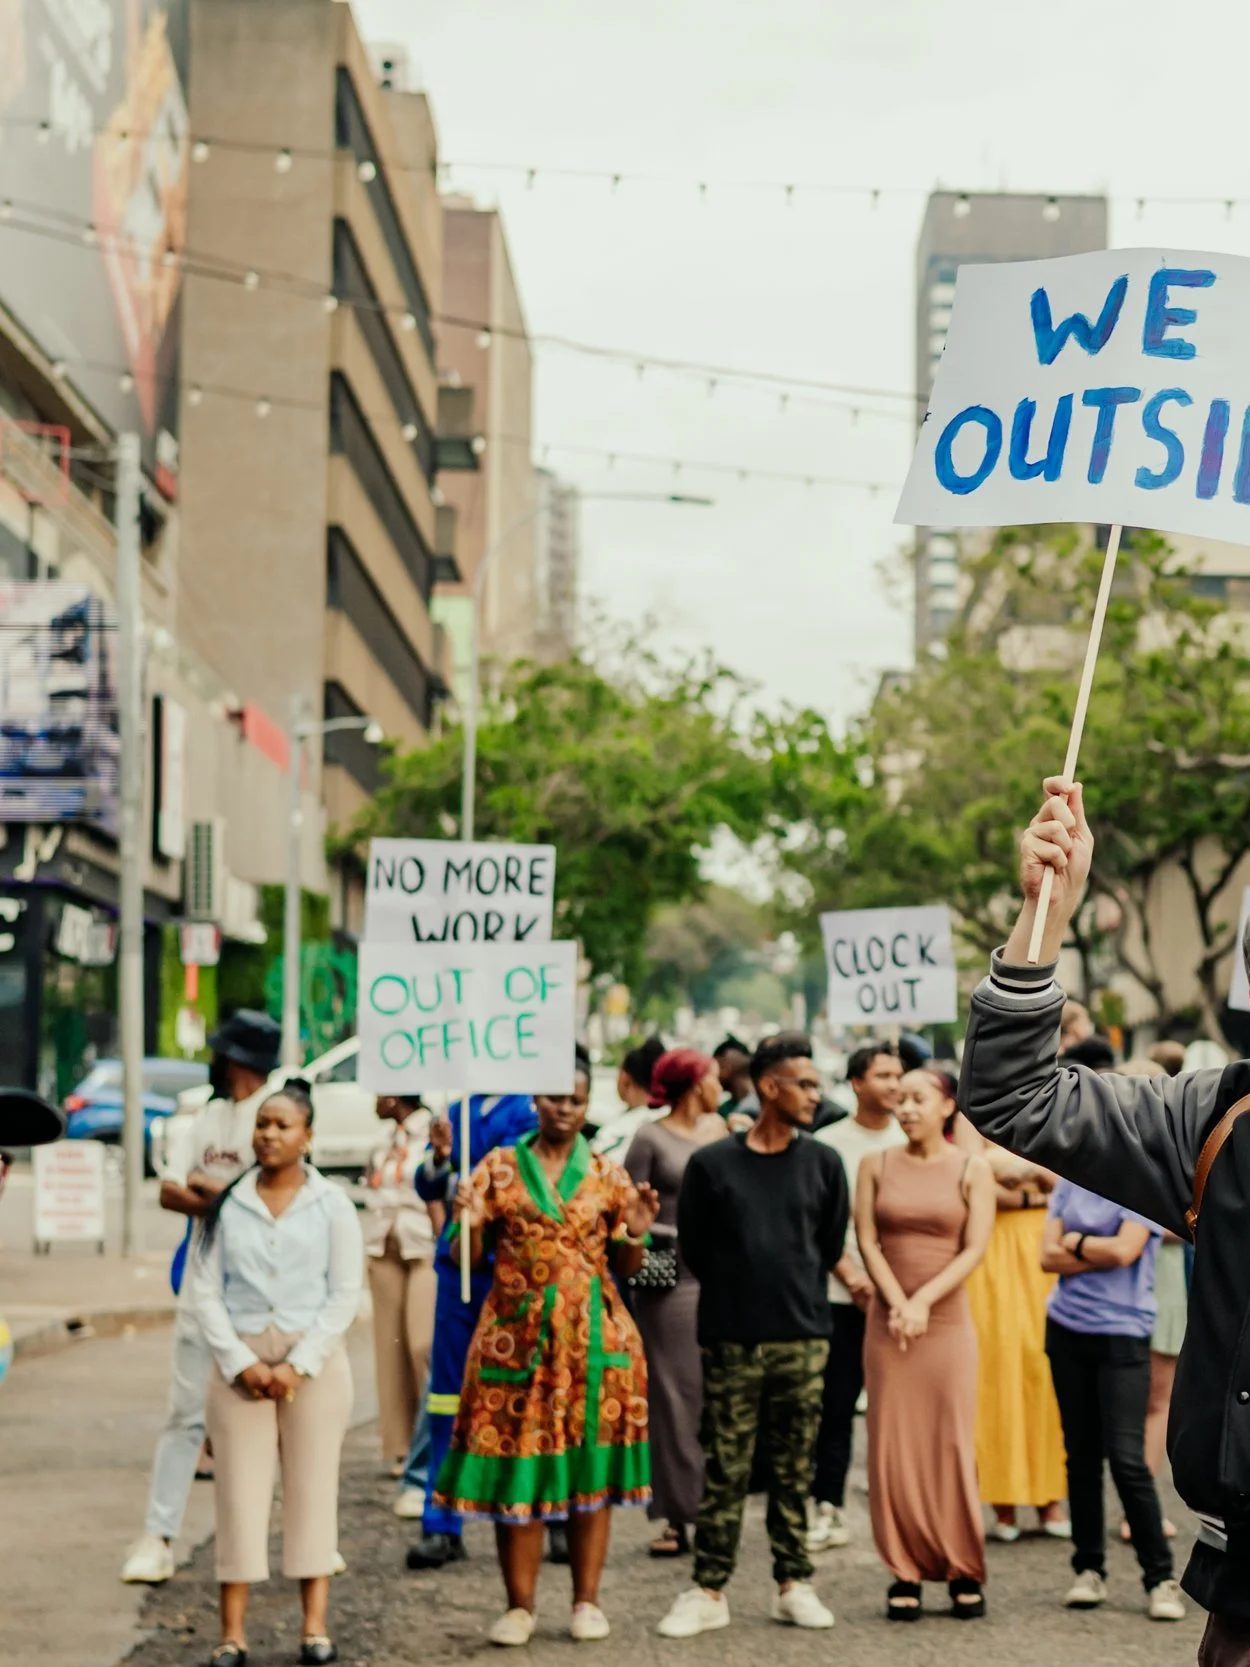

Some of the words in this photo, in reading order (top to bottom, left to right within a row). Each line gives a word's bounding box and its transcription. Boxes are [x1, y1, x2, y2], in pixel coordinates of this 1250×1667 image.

[1030, 268, 1217, 366] WE
[373, 856, 426, 895] NO
[442, 855, 547, 896] MORE
[410, 910, 541, 943] WORK
[832, 932, 938, 979] CLOCK
[369, 966, 474, 1016] OUT
[503, 963, 564, 1003] OF
[857, 976, 923, 1014] OUT
[380, 1012, 541, 1070] OFFICE
